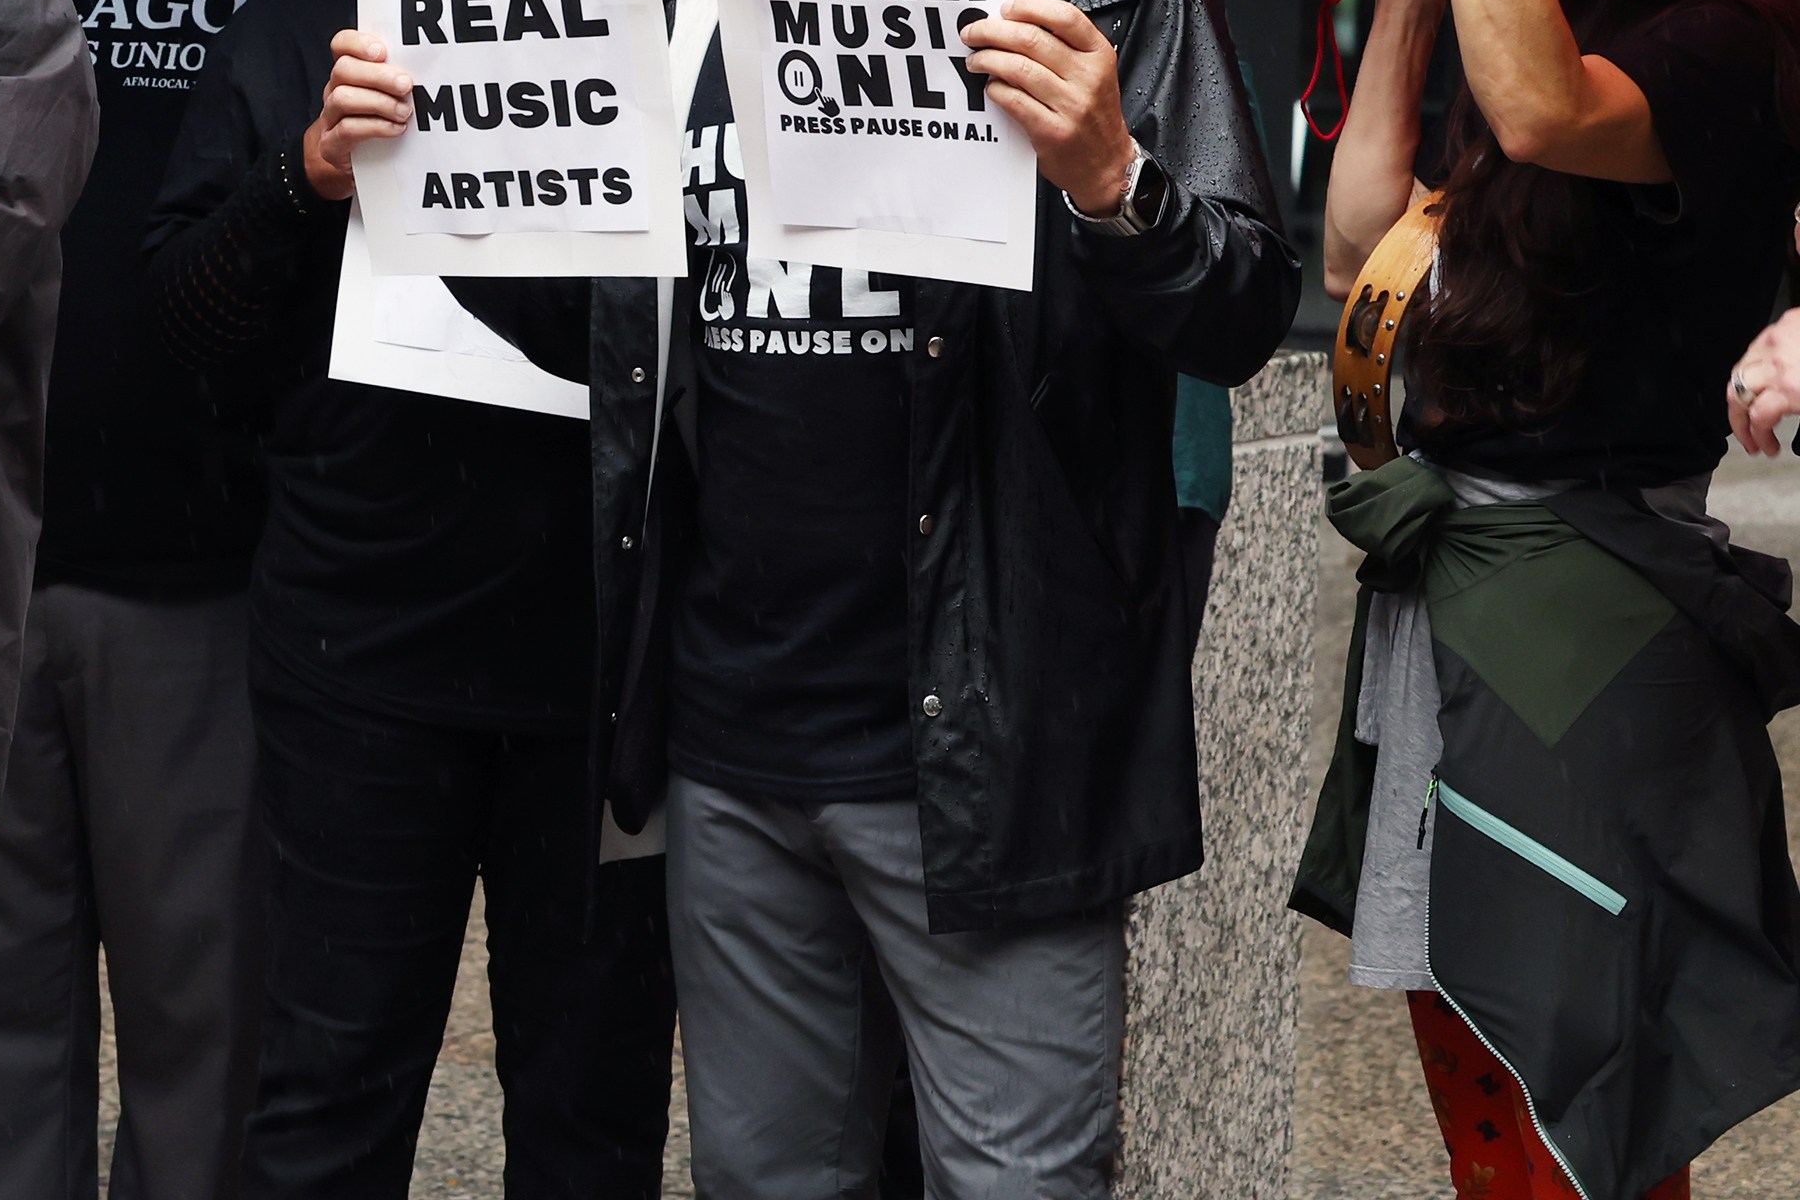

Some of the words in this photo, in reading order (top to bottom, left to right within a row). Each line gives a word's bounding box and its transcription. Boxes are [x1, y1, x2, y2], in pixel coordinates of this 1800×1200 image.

[111, 42, 206, 71] UNIO
[123, 77, 149, 87] AFM
[151, 78, 190, 89] LOCAL
[414, 77, 619, 132] MUSIC
[780, 114, 846, 135] PRESS
[851, 117, 923, 137] PAUSE
[928, 120, 959, 140] ON
[965, 124, 998, 142] A.I.
[421, 166, 633, 209] ARTISTS
[749, 330, 852, 355] PAUSE
[860, 327, 914, 354] ON
